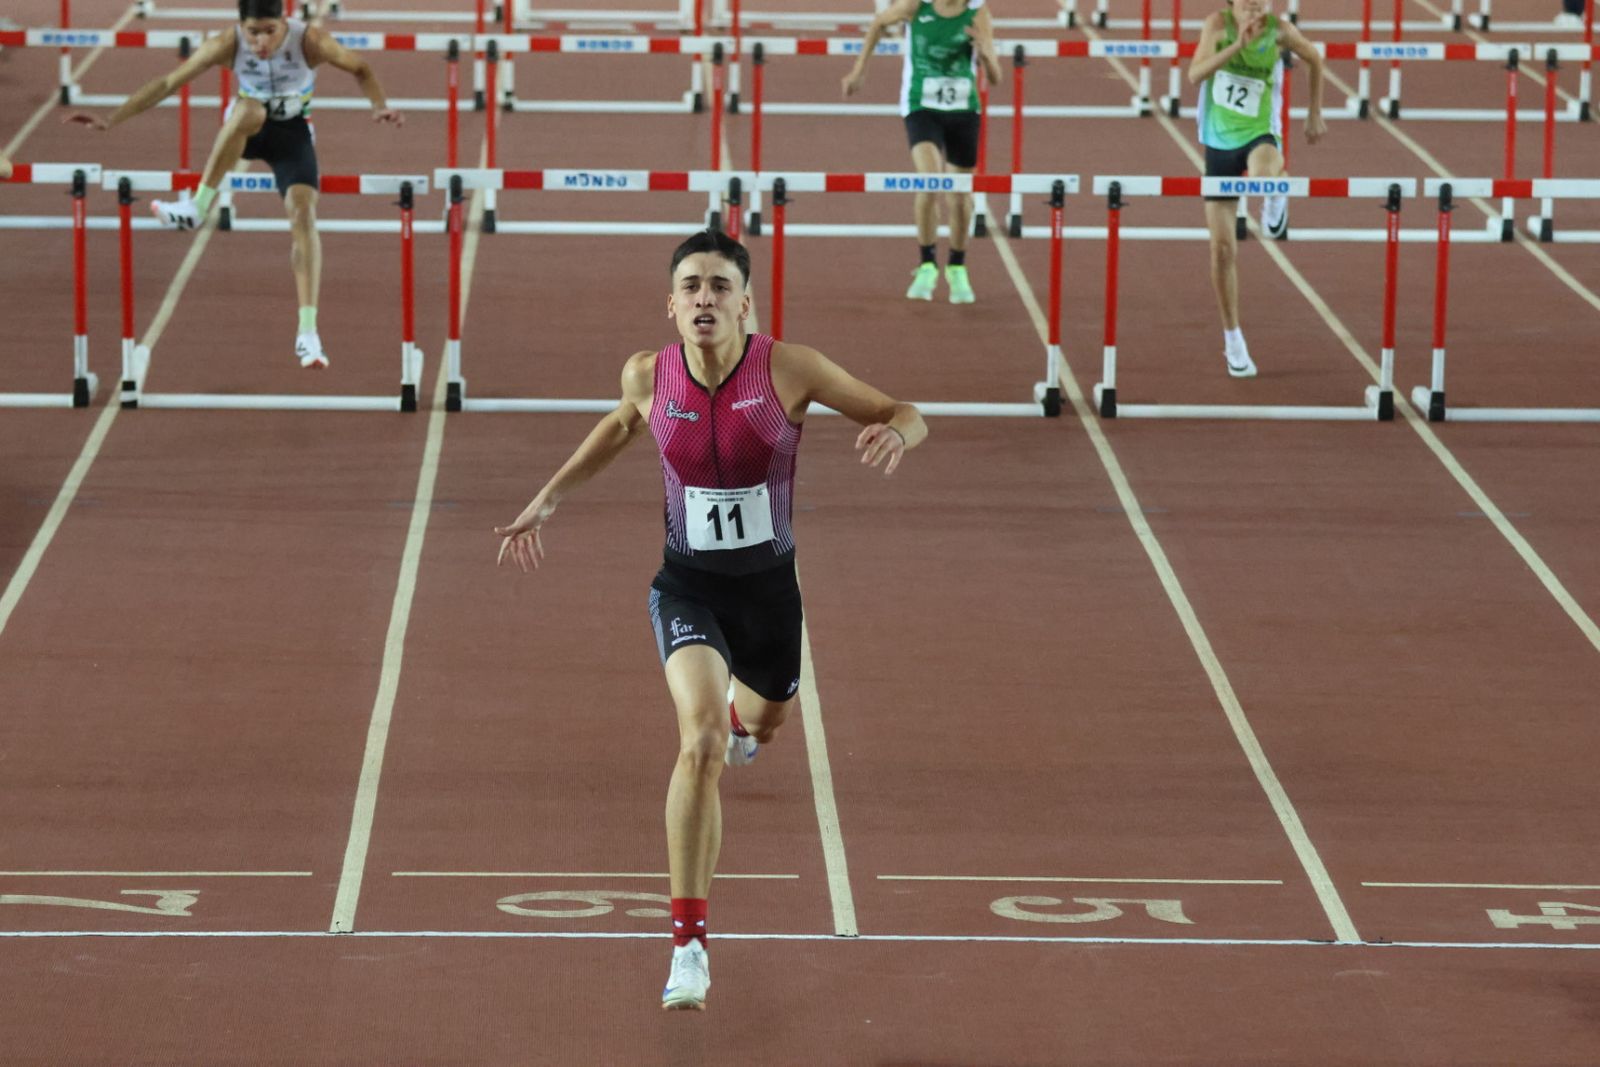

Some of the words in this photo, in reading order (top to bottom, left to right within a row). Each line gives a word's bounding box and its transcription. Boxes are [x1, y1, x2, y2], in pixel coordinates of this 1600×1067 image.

[43, 34, 98, 45] MONDO
[577, 39, 633, 50] MONDO
[843, 43, 899, 54] MODO
[1104, 45, 1162, 55] MONDO
[1372, 47, 1428, 58] MONDO
[936, 87, 956, 105] 13
[1225, 83, 1250, 109] 12
[231, 177, 272, 189] MON
[884, 177, 954, 190] MONDO
[1220, 181, 1289, 193] MONDO
[706, 503, 745, 541] 11
[496, 889, 672, 918] 6
[989, 895, 1196, 925] 5
